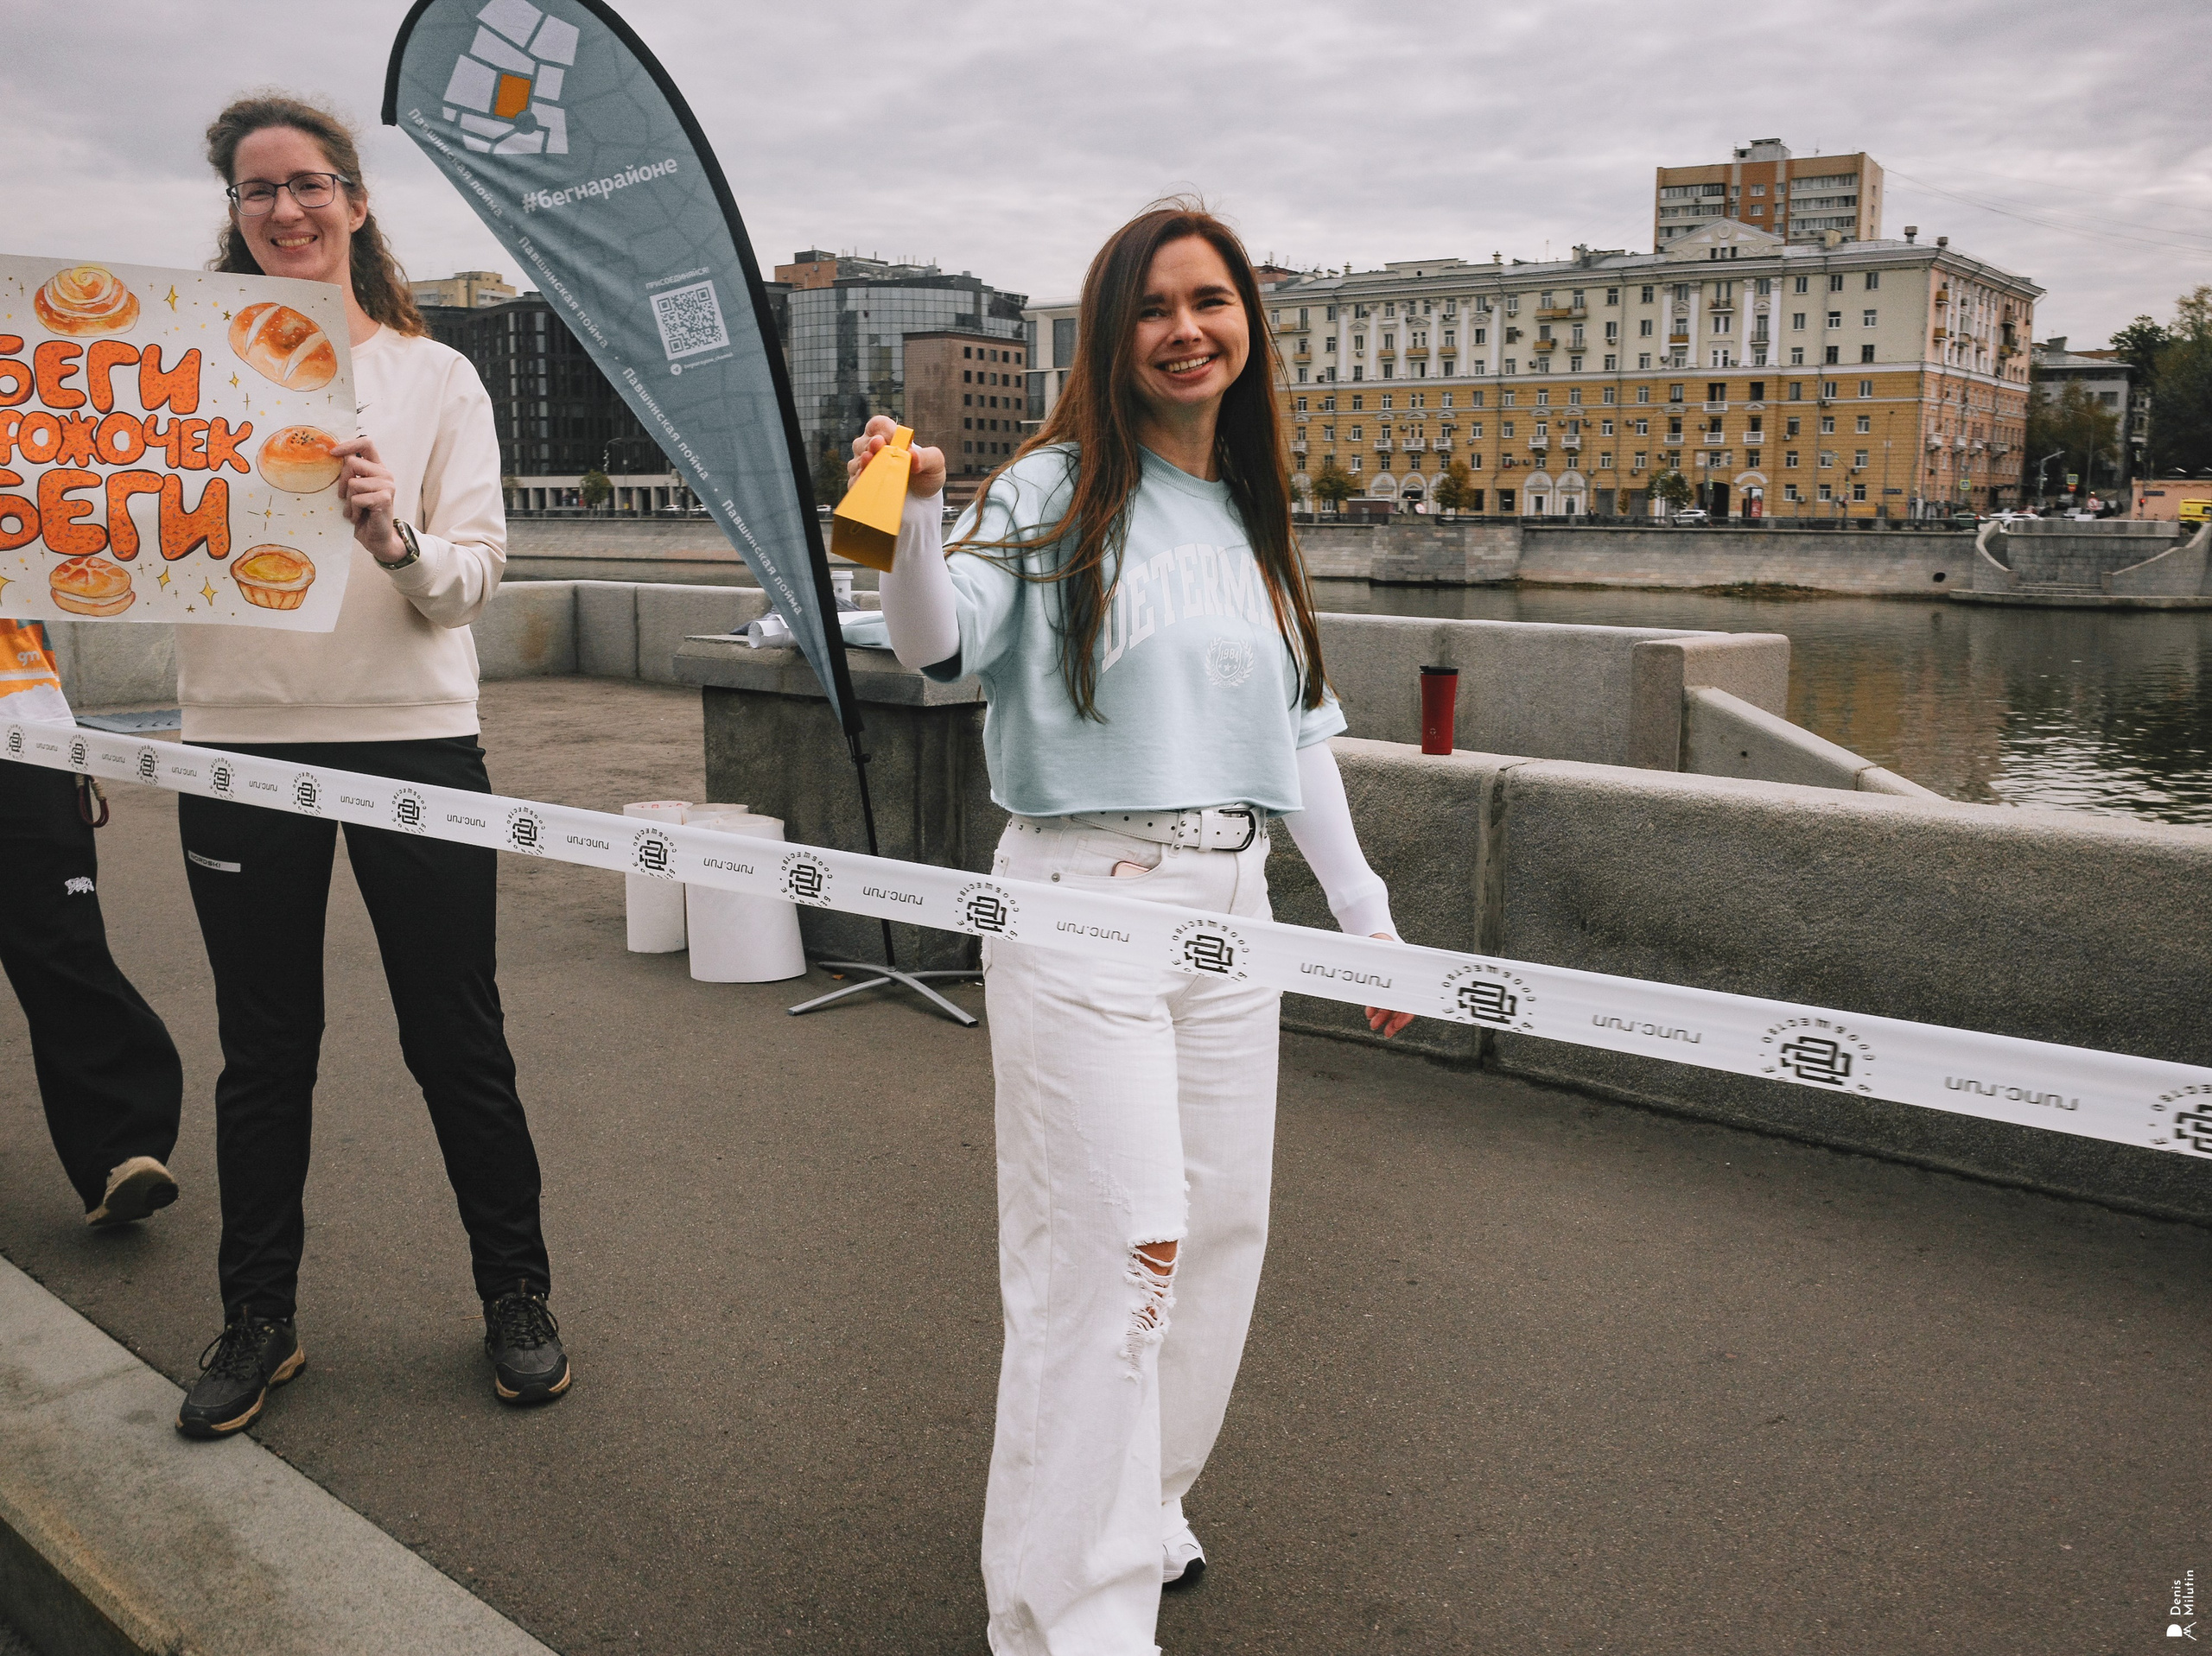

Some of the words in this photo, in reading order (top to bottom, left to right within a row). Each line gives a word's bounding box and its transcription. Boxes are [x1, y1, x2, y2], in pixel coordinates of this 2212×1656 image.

[408, 108, 474, 182] Павшинская
[471, 180, 503, 217] пойма
[522, 157, 678, 213] #бегнарайоне
[518, 237, 579, 311] Павшинская
[577, 309, 608, 348] пойма
[622, 367, 681, 442] Павшинская
[678, 441, 709, 480] пойма
[721, 499, 777, 575] Павшинская
[774, 574, 803, 615] пойма
[1219, 648, 1239, 663] 1984
[249, 780, 278, 792] runc.run
[340, 795, 374, 809] runc.run
[447, 814, 486, 828] runc.run
[567, 834, 610, 850] runc.run
[703, 858, 754, 874] runc.run
[780, 851, 833, 880] СООБЩЕСТВО
[863, 885, 924, 906] runc.run
[957, 882, 1020, 912] СООБЩЕСТВО
[1057, 921, 1130, 943] runc.run
[1173, 919, 1250, 955] СООБЩЕСТВО
[1300, 961, 1392, 988] runc.run
[1592, 1014, 1701, 1044] runc.run
[1944, 1076, 2080, 1112] runc.run
